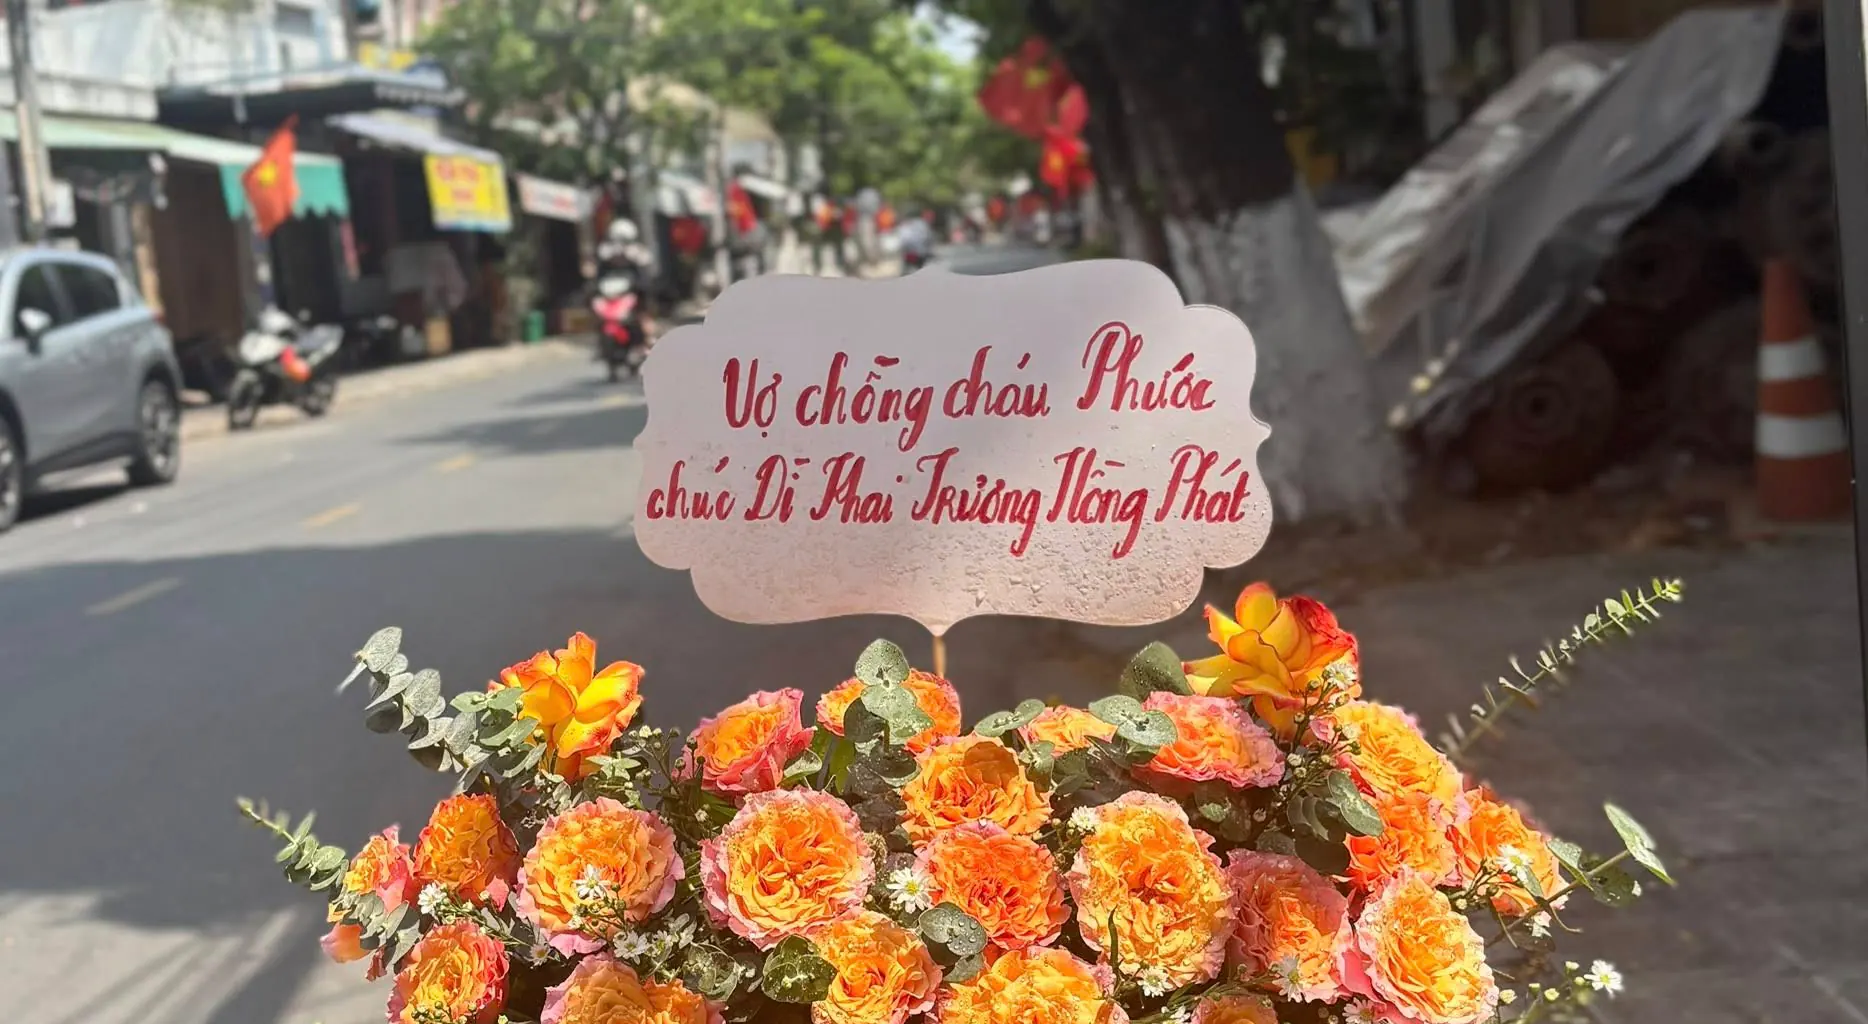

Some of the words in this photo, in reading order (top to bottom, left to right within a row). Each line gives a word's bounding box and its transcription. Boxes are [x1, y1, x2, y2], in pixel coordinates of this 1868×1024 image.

[723, 356, 782, 438] Vợ
[795, 351, 935, 453] chồng
[942, 345, 1051, 419] cháu
[1076, 320, 1216, 414] Phước
[645, 456, 735, 522] chúc
[808, 451, 905, 525] Khai
[911, 446, 1042, 559] Trương
[1045, 446, 1150, 561] Hồng
[1153, 443, 1252, 526] Phát
